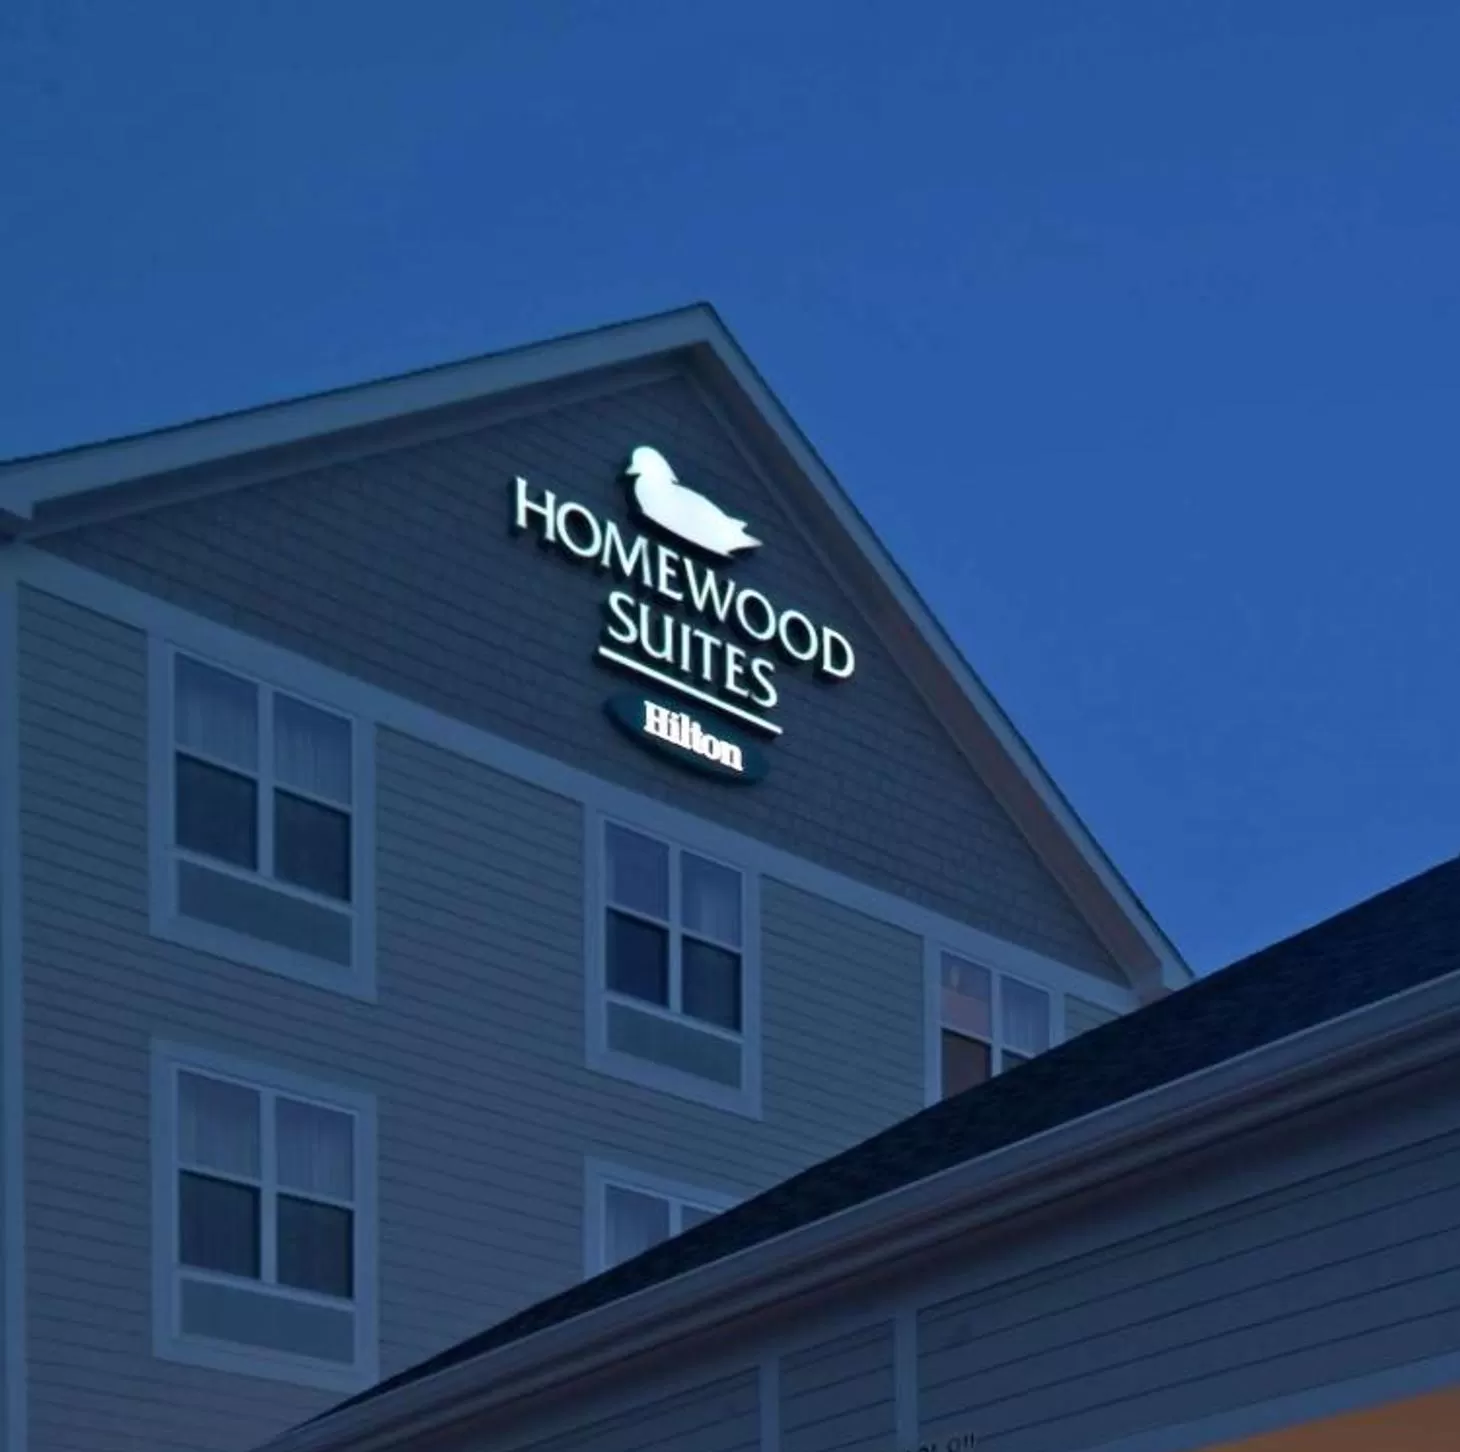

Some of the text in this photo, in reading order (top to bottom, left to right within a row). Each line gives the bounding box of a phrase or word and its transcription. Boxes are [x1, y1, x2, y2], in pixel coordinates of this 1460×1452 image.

[515, 476, 855, 679] HOMEWOOD
[607, 590, 778, 708] SUITES
[643, 699, 744, 771] Hilton
